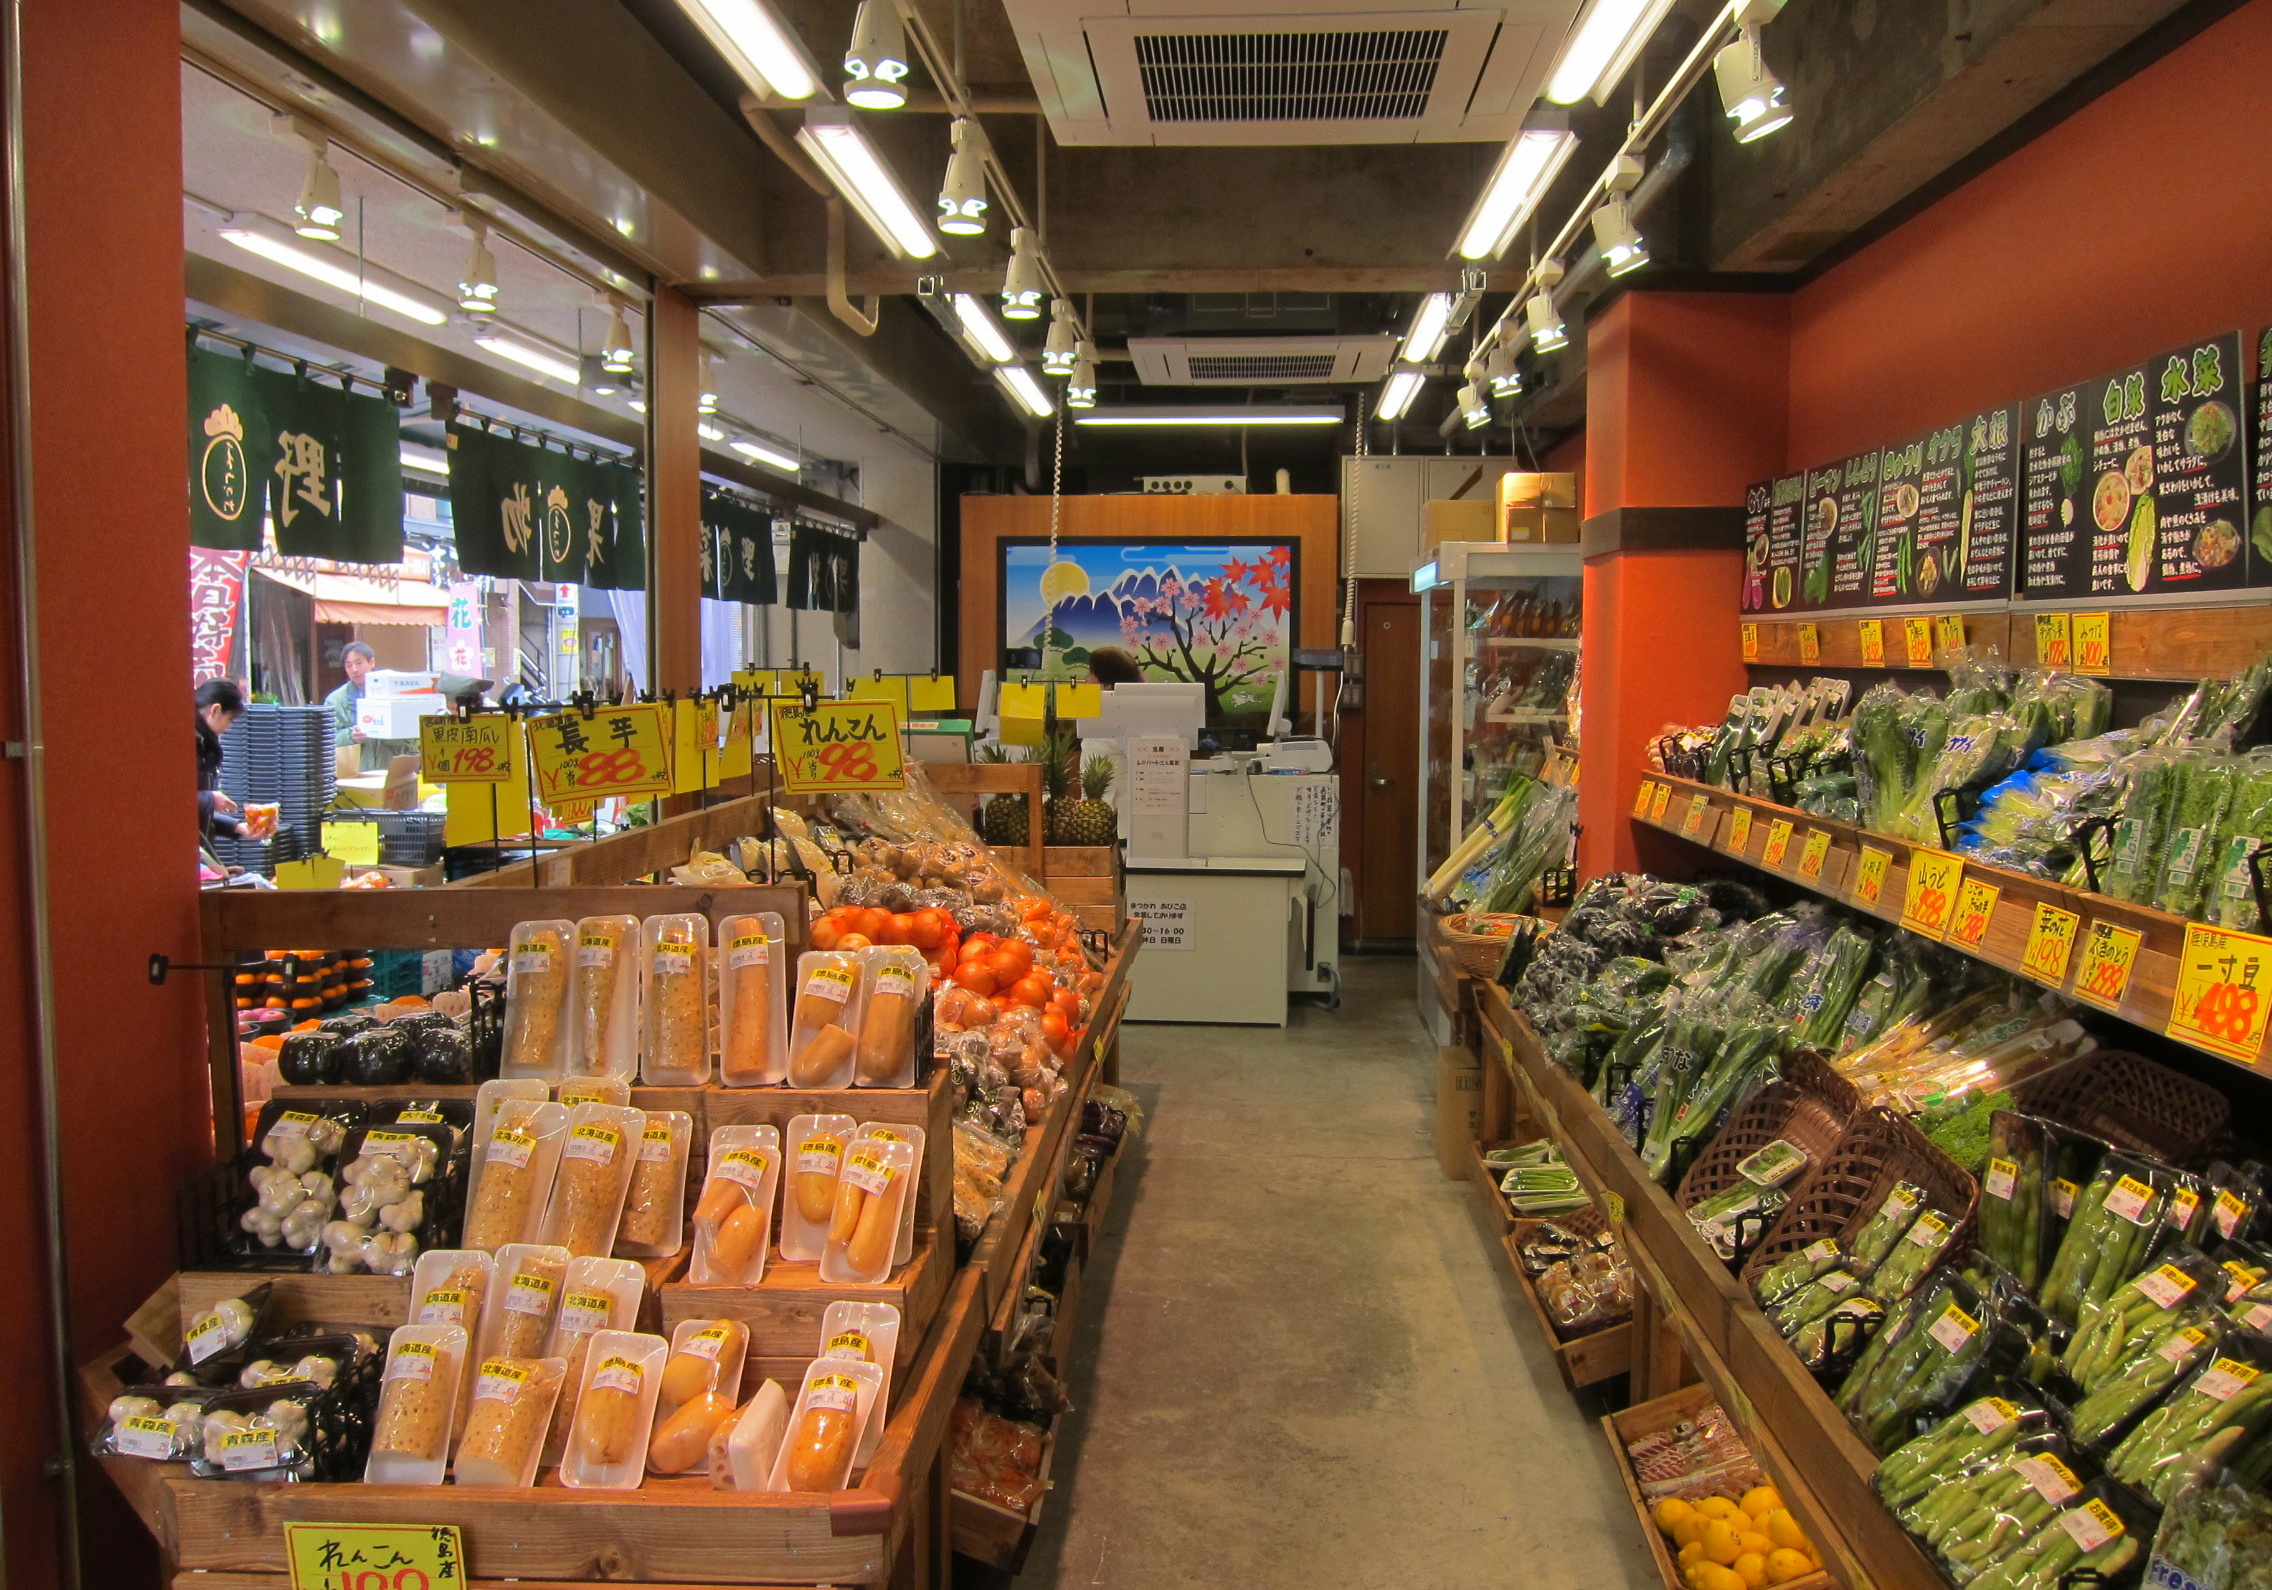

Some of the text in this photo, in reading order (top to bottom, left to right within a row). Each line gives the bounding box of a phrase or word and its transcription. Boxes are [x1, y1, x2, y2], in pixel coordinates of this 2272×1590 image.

[2160, 344, 2224, 404] 水菜
[2103, 372, 2146, 426] 白菜
[2035, 391, 2076, 438] かぶ
[1970, 410, 2009, 455] 大根
[452, 598, 472, 629] 花
[454, 649, 468, 666] 花
[555, 717, 638, 756] 長芋
[798, 713, 887, 745] れんこん
[453, 747, 497, 774] 198
[575, 747, 648, 788] 88
[818, 741, 879, 782] 98
[1918, 862, 1951, 890] 山うど
[2039, 908, 2070, 936] 菜の花
[1160, 936, 1182, 944] 日曜日
[2088, 937, 2129, 967] ふきのとう
[2034, 937, 2065, 975] 198
[2196, 953, 2260, 992] 一寸豆
[576, 1126, 615, 1143] 北海道産
[641, 1130, 668, 1141] 海道産
[803, 1142, 839, 1155] 徳島産
[728, 1151, 764, 1169] 徳島産
[567, 1295, 609, 1310] 北海道産
[189, 1316, 221, 1340] 青森産
[699, 1329, 723, 1342] 島産
[830, 1336, 864, 1350] 徳島産
[481, 1362, 522, 1380] 北海道産
[128, 1417, 172, 1433] 青森産
[226, 1431, 271, 1445] 青森産
[317, 1538, 415, 1572] れんこん
[431, 1527, 458, 1579] 徳島産
